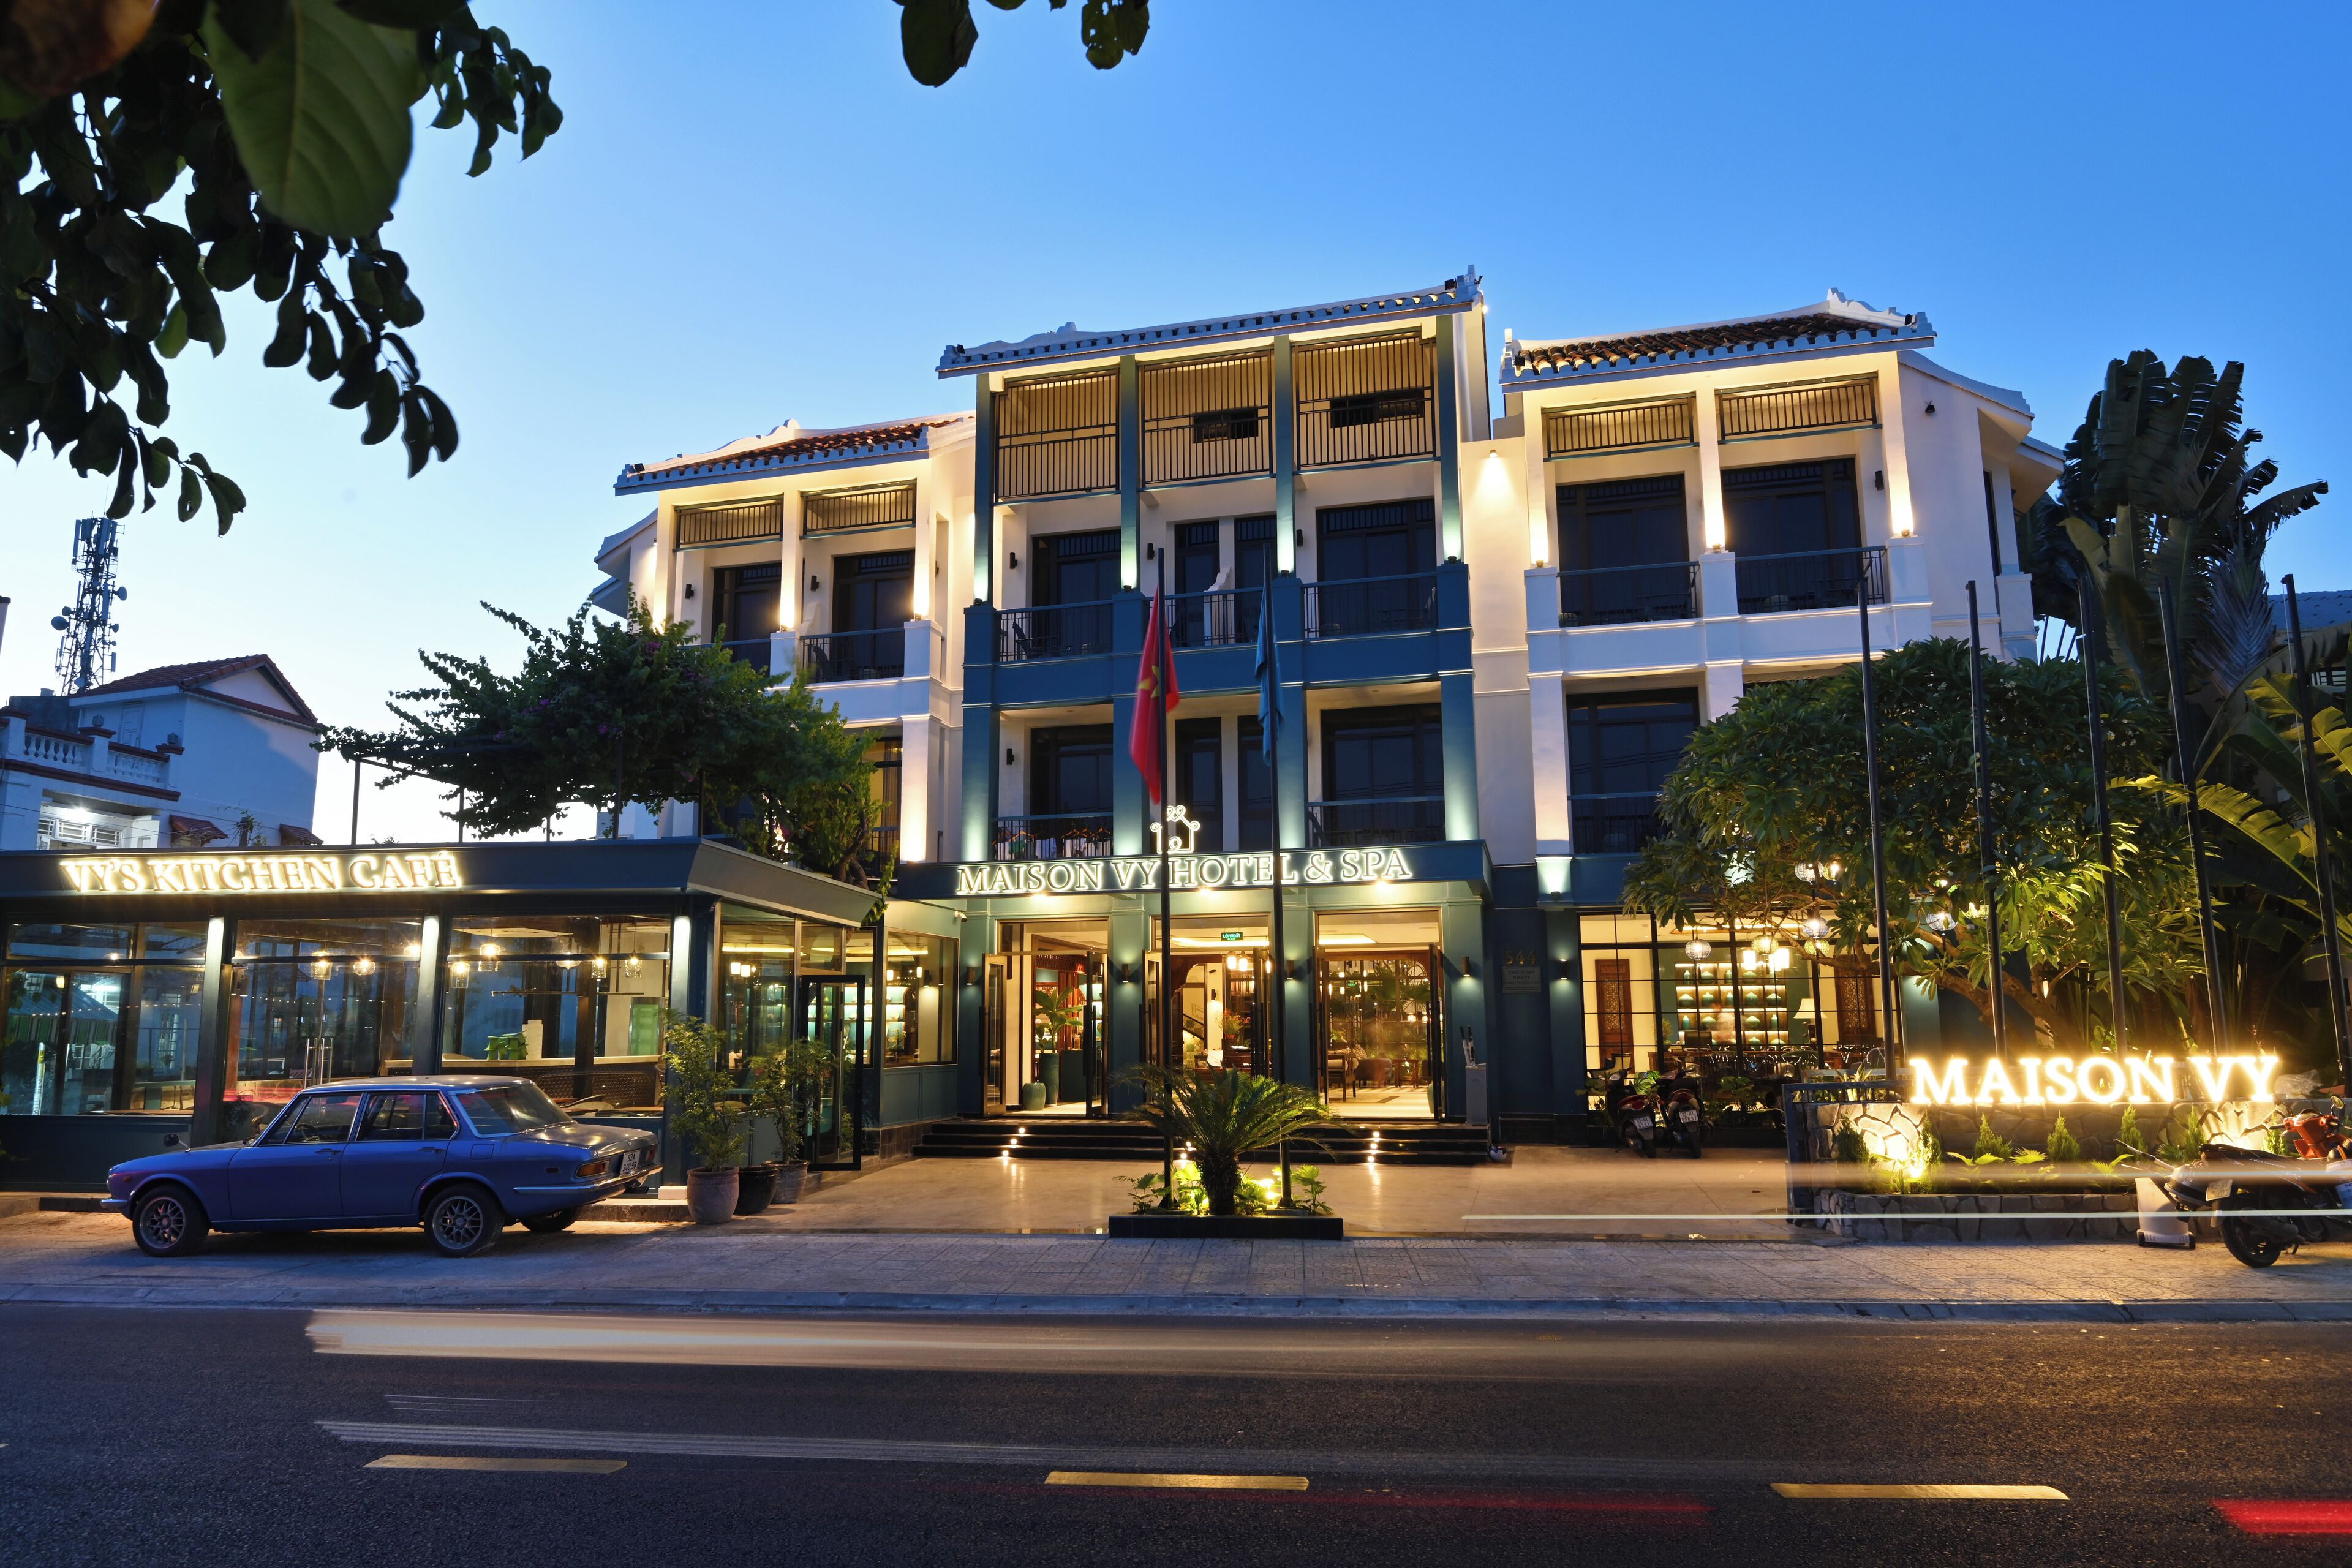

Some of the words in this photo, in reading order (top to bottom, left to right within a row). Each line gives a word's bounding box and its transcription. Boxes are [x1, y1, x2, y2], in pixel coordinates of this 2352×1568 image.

[59, 859, 143, 892] VY'S
[148, 858, 341, 892] KITCHEN
[350, 850, 460, 889] CAFÉ
[956, 863, 1102, 893] MAISON
[1111, 859, 1161, 888] VY
[1167, 854, 1298, 886] HOTEL
[1304, 851, 1333, 882] &
[1342, 848, 1411, 880] SPA
[1504, 951, 1536, 965] 544
[1909, 1057, 2175, 1103] MAISON
[2190, 1056, 2279, 1102] VY
